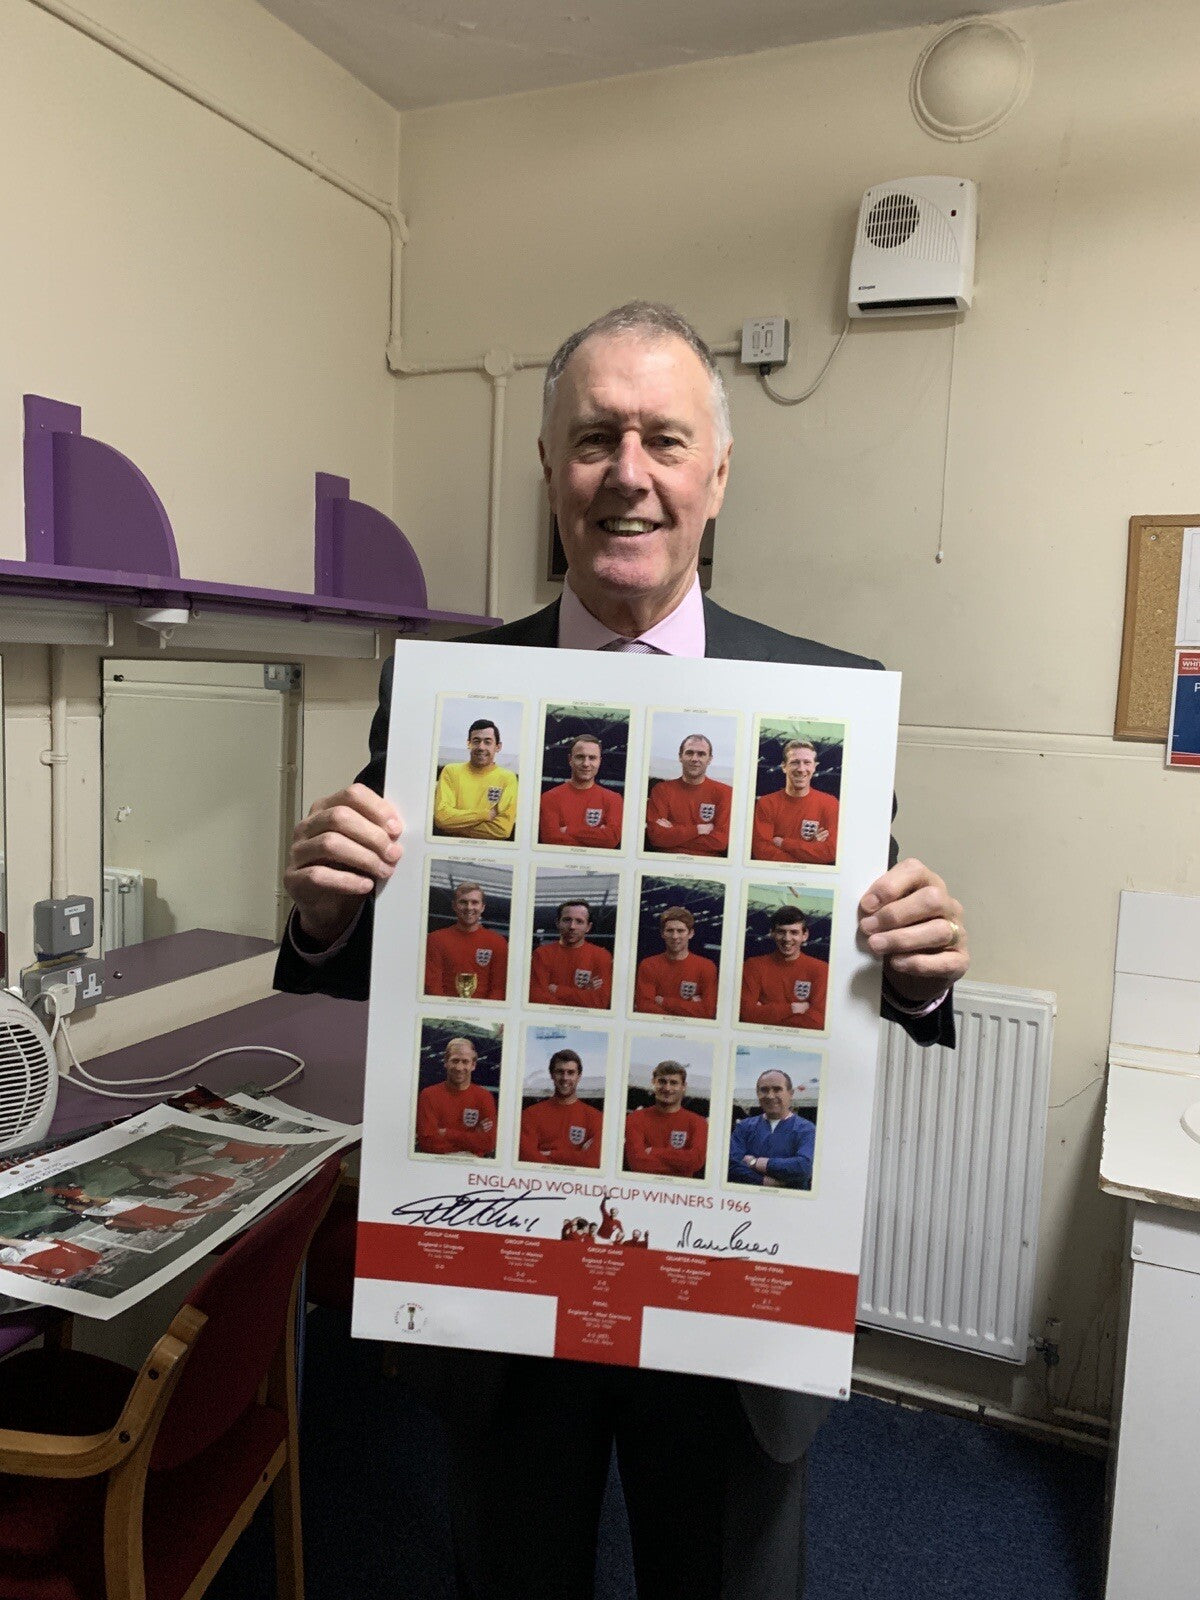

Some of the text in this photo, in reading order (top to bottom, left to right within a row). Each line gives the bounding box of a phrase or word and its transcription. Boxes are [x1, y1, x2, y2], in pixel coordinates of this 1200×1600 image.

[467, 1173, 752, 1214] ENGLAND WORLD CUP WINNERS 1966
